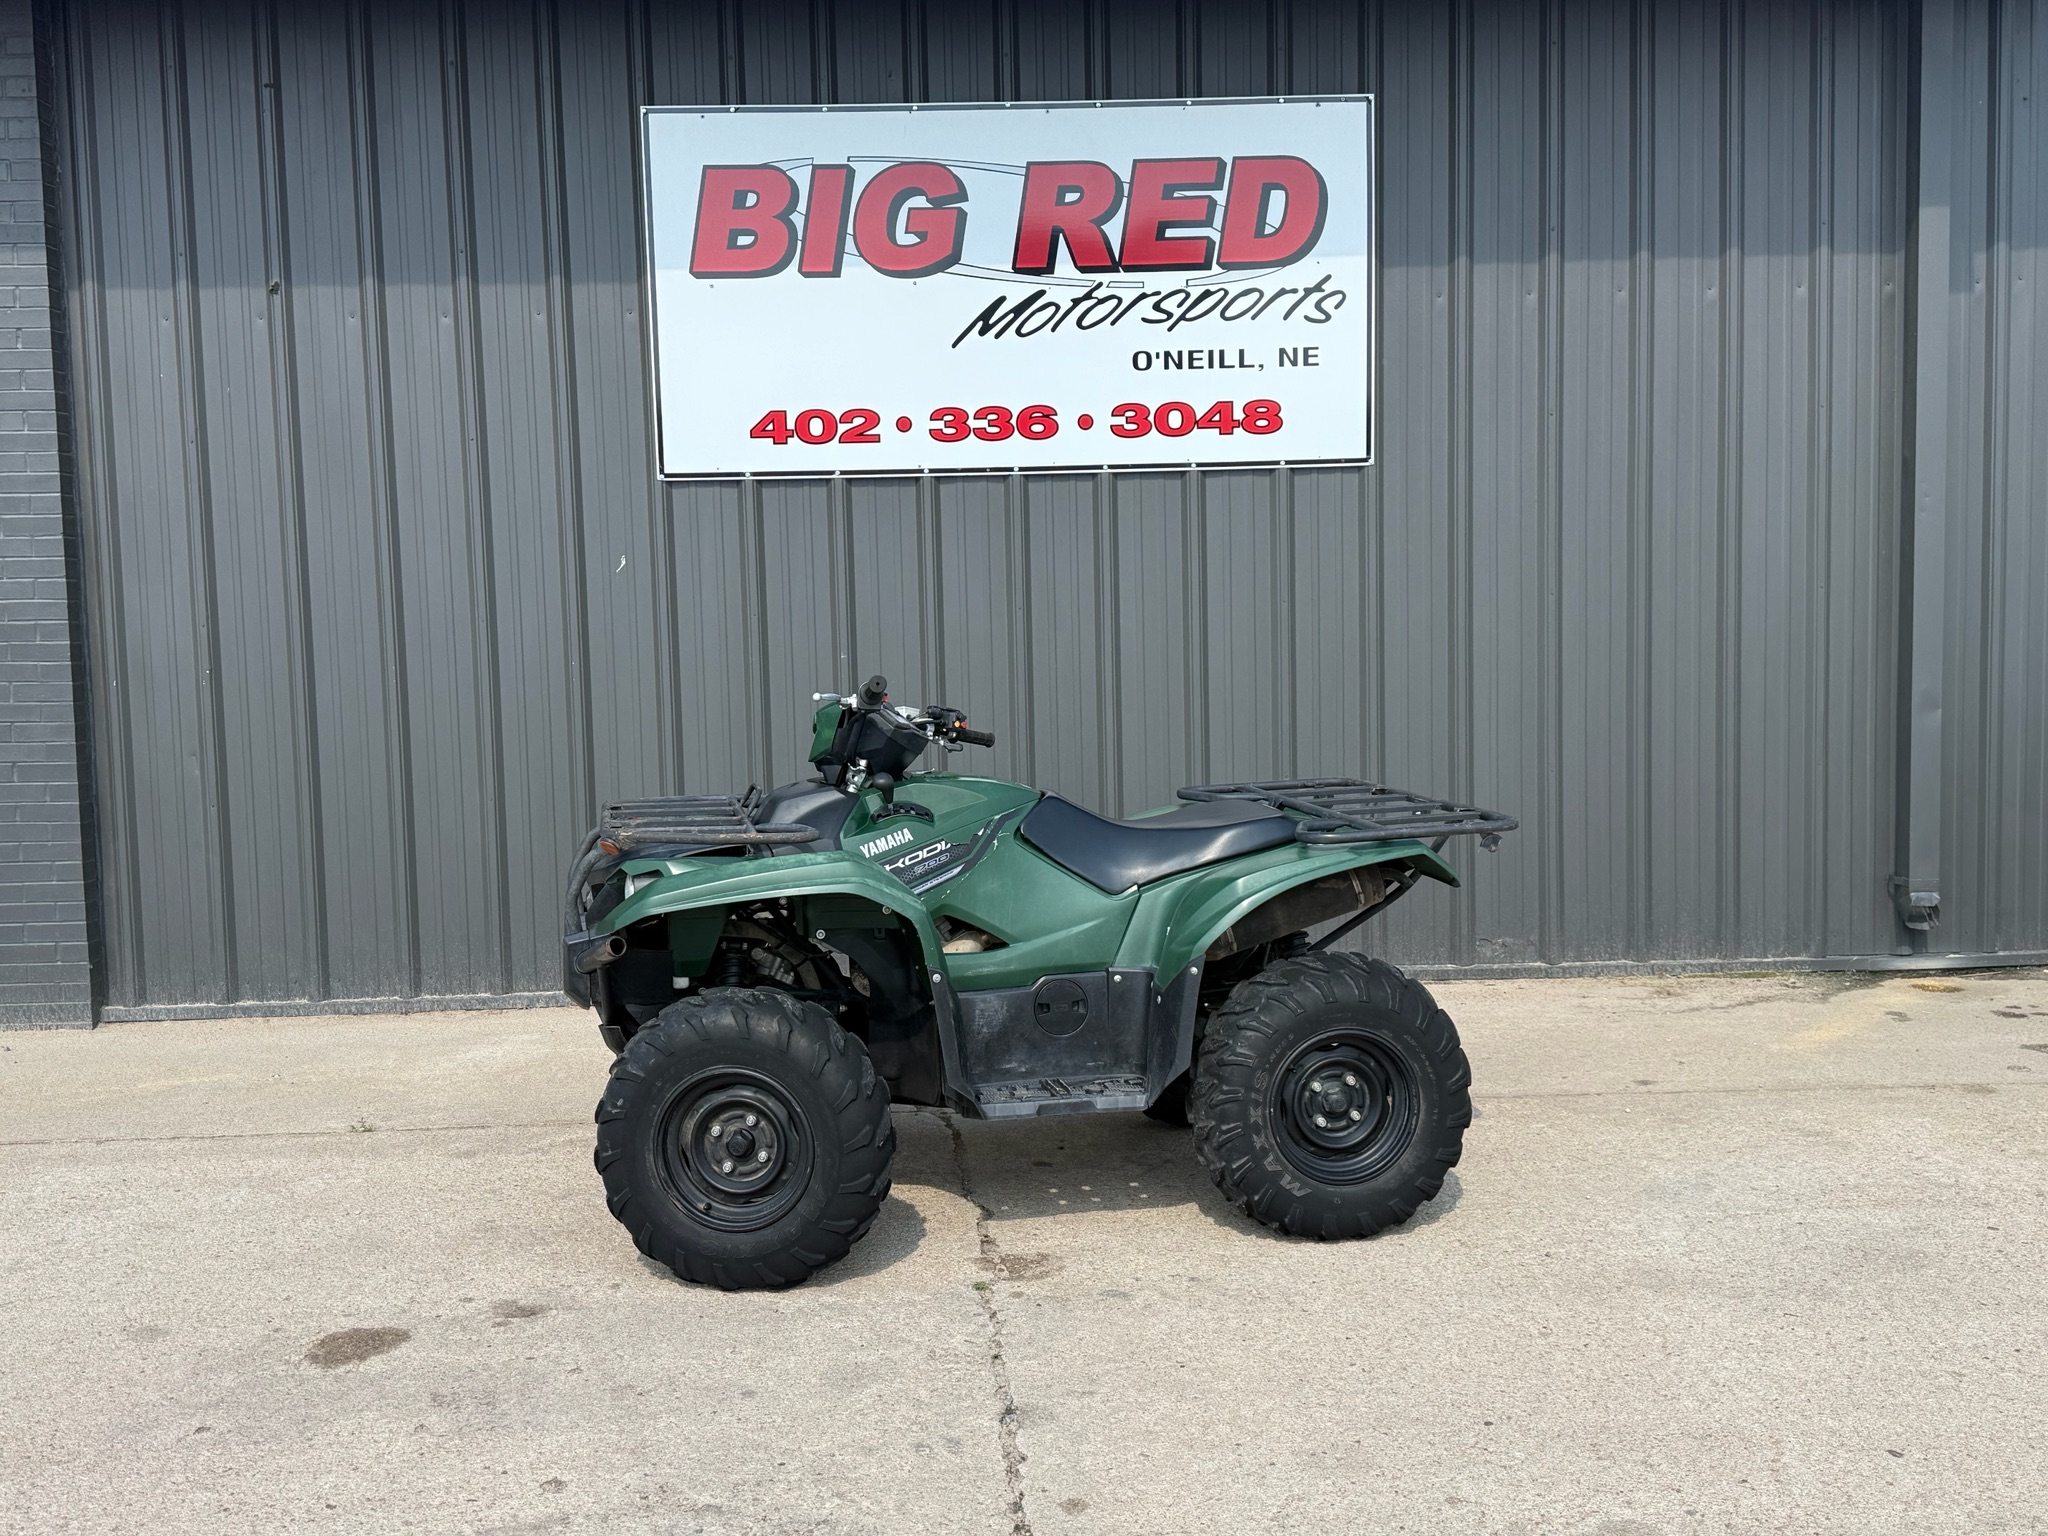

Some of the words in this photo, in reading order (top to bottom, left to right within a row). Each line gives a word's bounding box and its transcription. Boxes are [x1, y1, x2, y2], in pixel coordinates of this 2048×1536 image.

[689, 161, 969, 279] BIG
[1012, 155, 1329, 275] RED
[951, 273, 1347, 348] Motorsports
[1132, 347, 1264, 371] O'NEILL,
[1278, 346, 1319, 367] NE
[750, 408, 881, 445] 402
[928, 404, 1059, 443] 336
[1110, 399, 1284, 439] 3048
[859, 827, 914, 859] YAMAHA
[1249, 1069, 1314, 1198] MAXXIS
